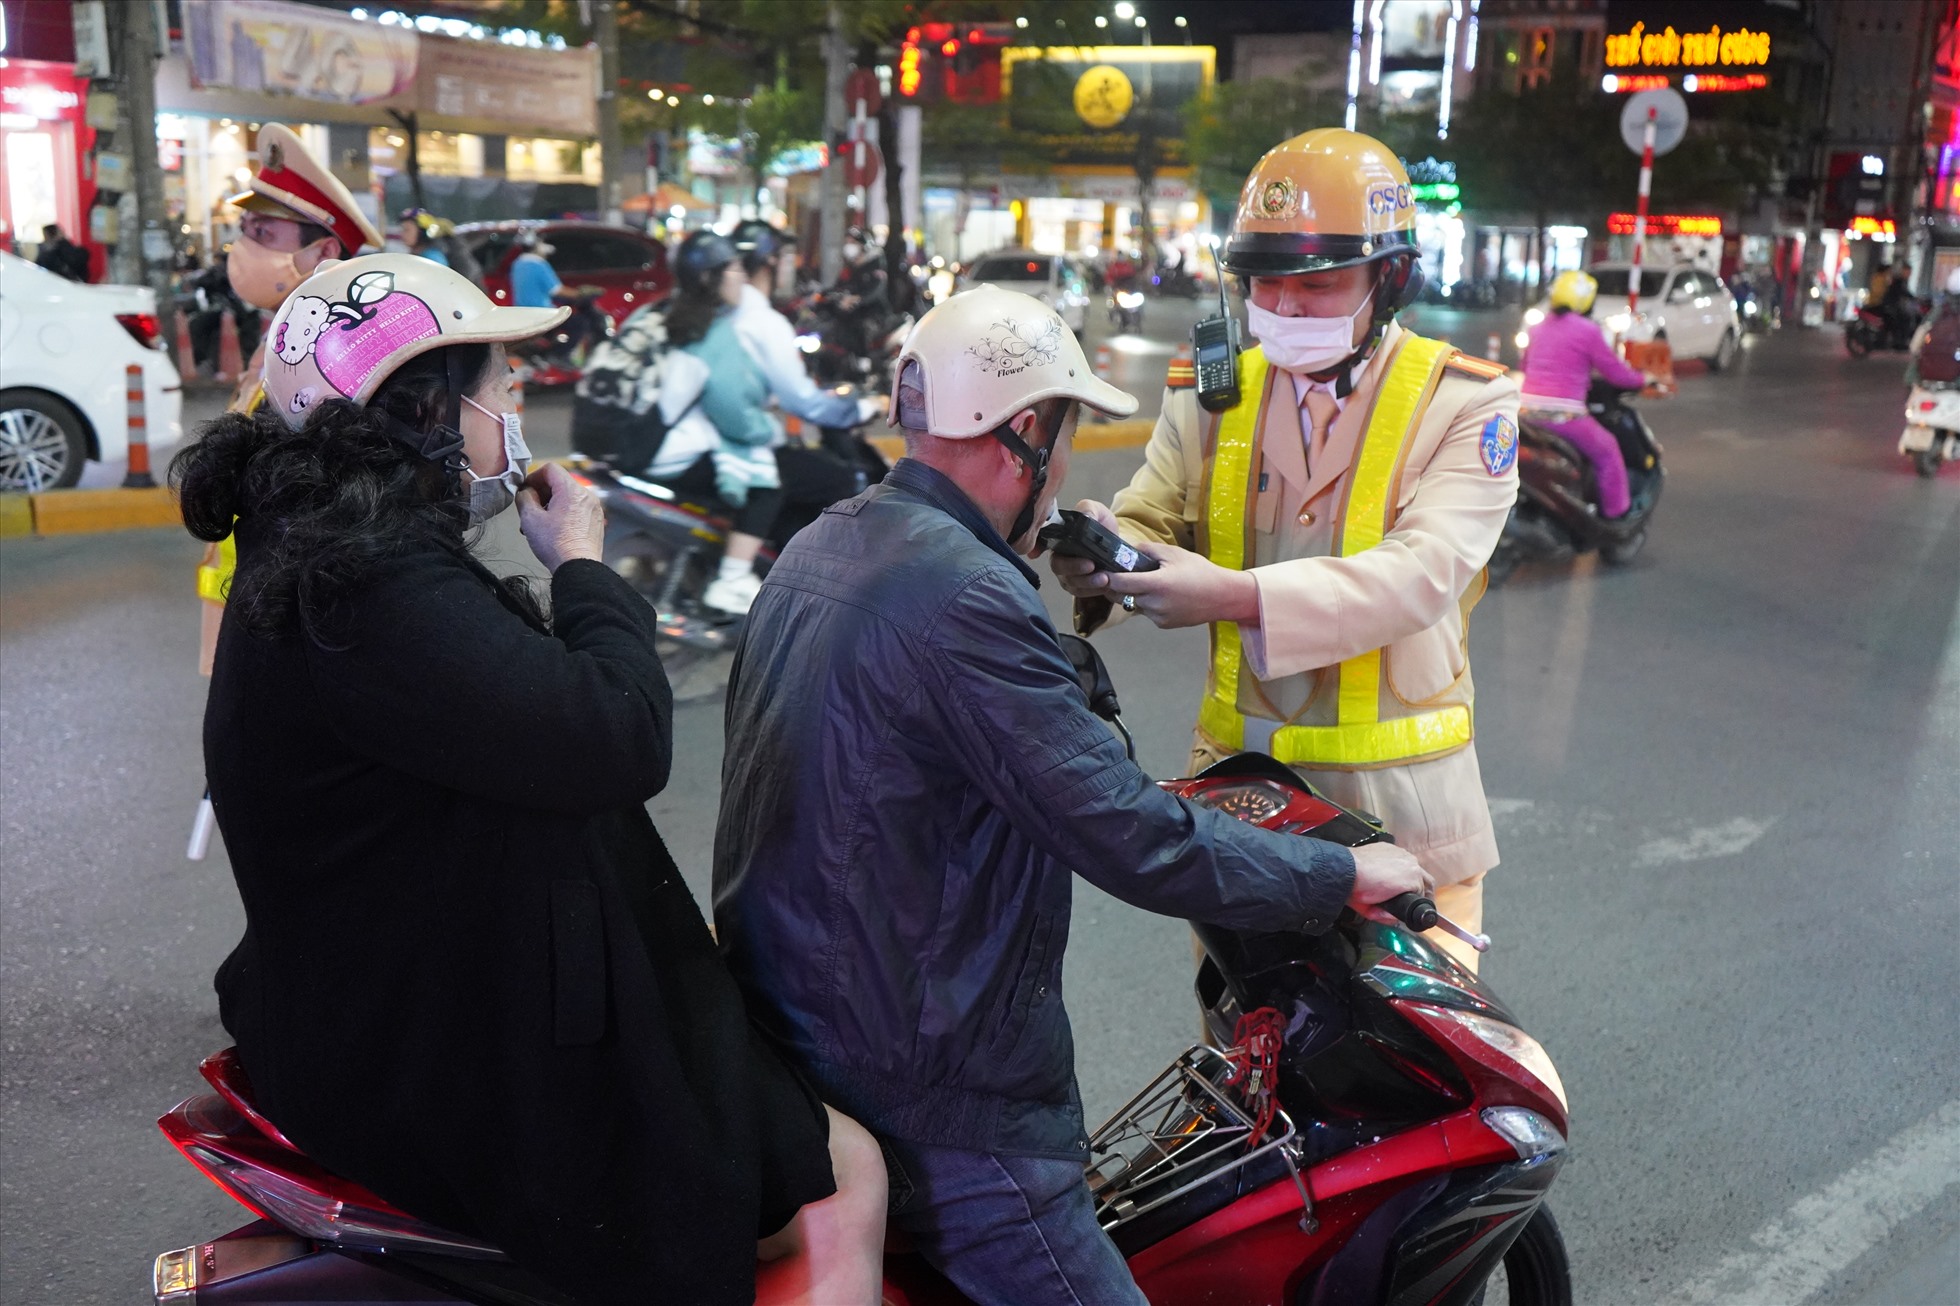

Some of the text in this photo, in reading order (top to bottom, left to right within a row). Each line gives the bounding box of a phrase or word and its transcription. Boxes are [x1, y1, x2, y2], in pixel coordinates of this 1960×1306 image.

[336, 343, 356, 361] HELLO
[356, 327, 377, 345] KITTY
[379, 314, 401, 329] HELLO
[400, 303, 420, 317] KITTY
[383, 308, 428, 337] HELLO
[349, 318, 435, 378] KITTY HELLO
[997, 366, 1025, 378] Flower
